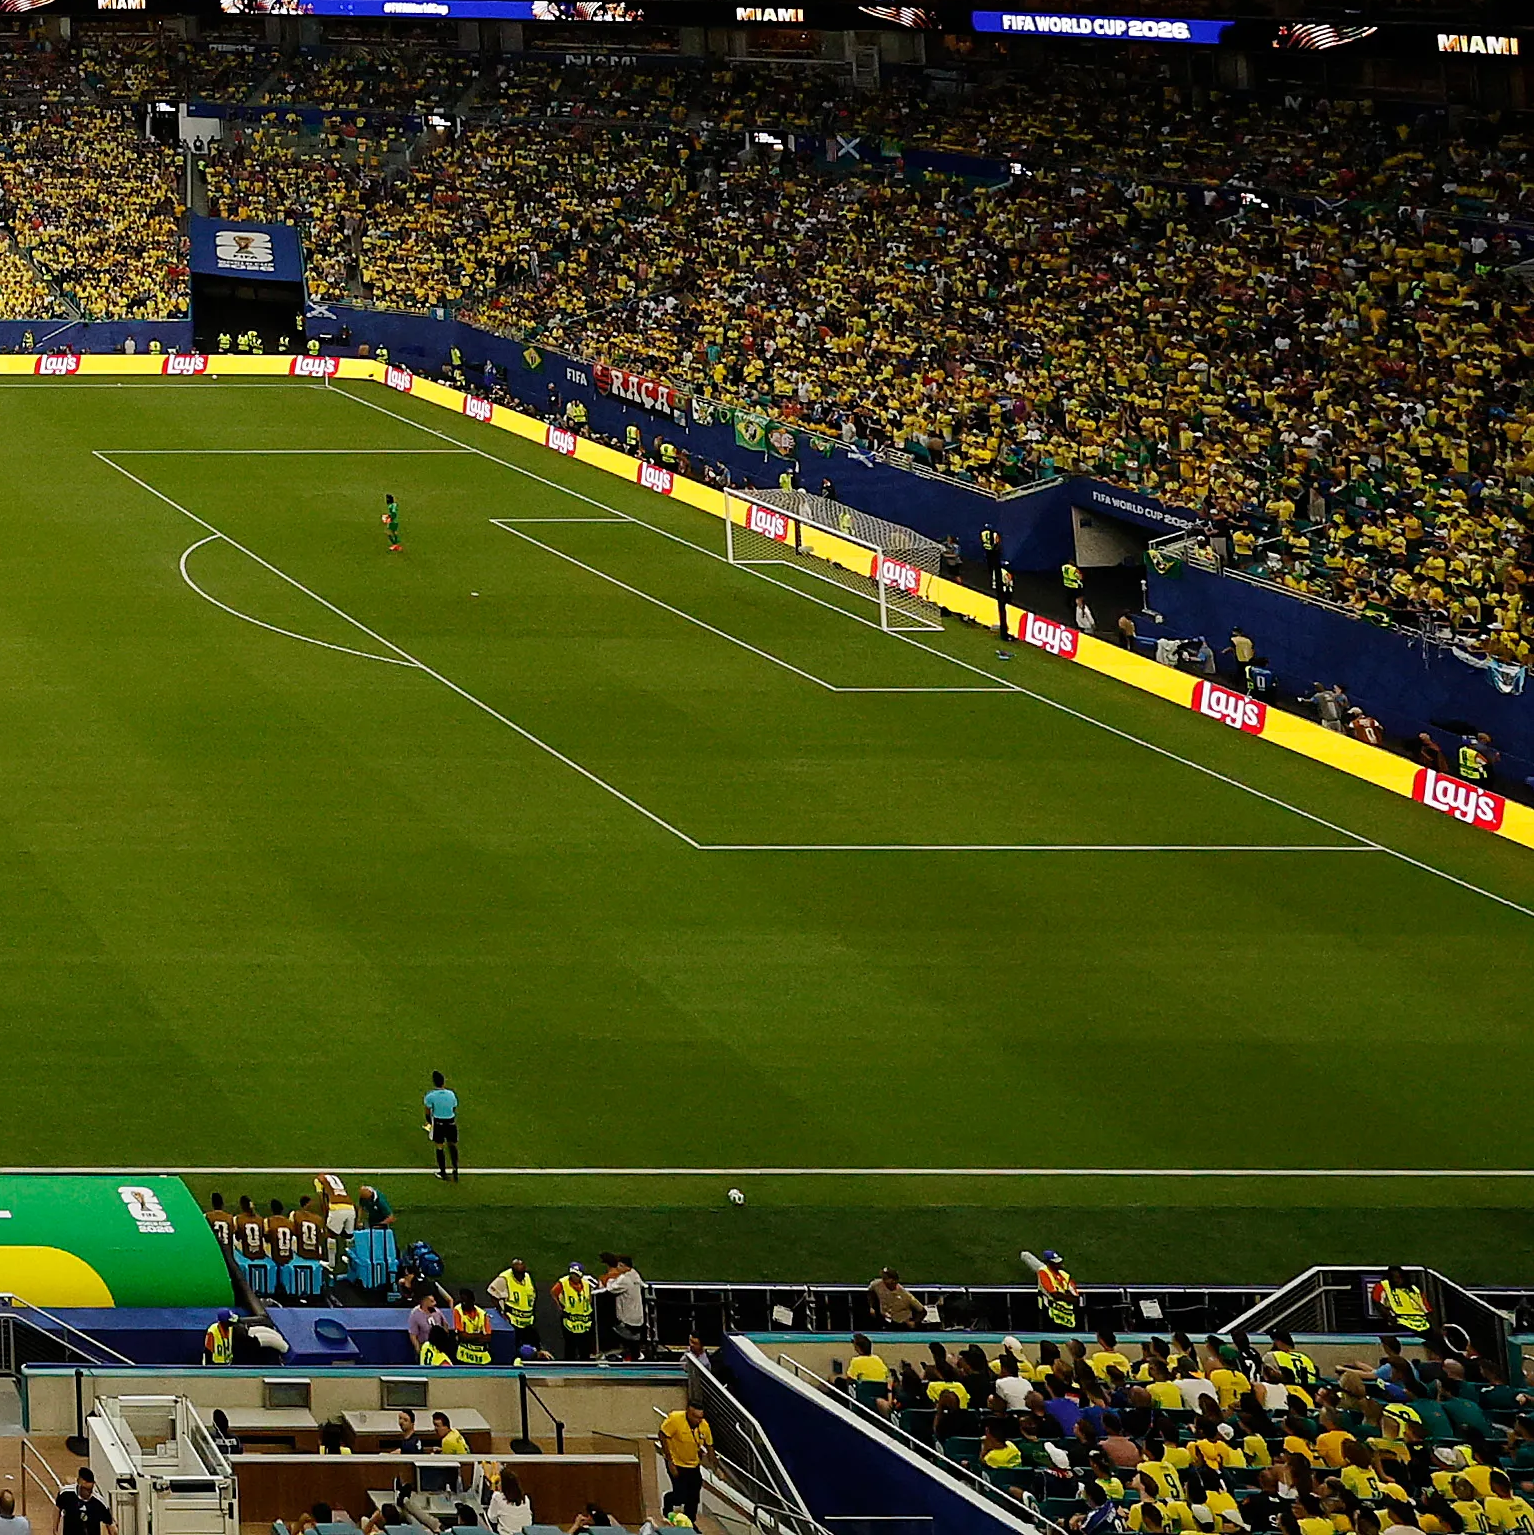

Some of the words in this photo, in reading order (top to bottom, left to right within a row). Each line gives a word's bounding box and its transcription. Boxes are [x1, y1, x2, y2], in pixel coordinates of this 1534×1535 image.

[736, 7, 804, 22] MIAMI
[1003, 15, 1034, 31] FIFA
[1035, 16, 1091, 34] WORLD
[1093, 18, 1127, 36] CUP
[1128, 21, 1190, 39] 2026
[1437, 34, 1519, 55] MIAMI
[40, 355, 77, 375] Lay's
[167, 355, 205, 375] Lay's
[295, 357, 337, 377] Lay's
[566, 367, 588, 387] FIFA
[387, 367, 413, 392] Lay's
[611, 369, 670, 413] RAÇA
[466, 396, 491, 421] Lay's
[548, 426, 575, 455] Lay's
[641, 462, 672, 494] Lay's
[1092, 490, 1110, 504] FIFA
[1111, 497, 1144, 515] WORLD
[1144, 507, 1163, 521] CUP
[750, 506, 787, 540] Lay's
[876, 557, 918, 596] ay's
[1025, 615, 1074, 655] Lay's
[1200, 681, 1261, 731] Lay's
[1425, 769, 1496, 825] Lay's
[139, 1225, 176, 1233] 2026
[1163, 1473, 1180, 1499] 9
